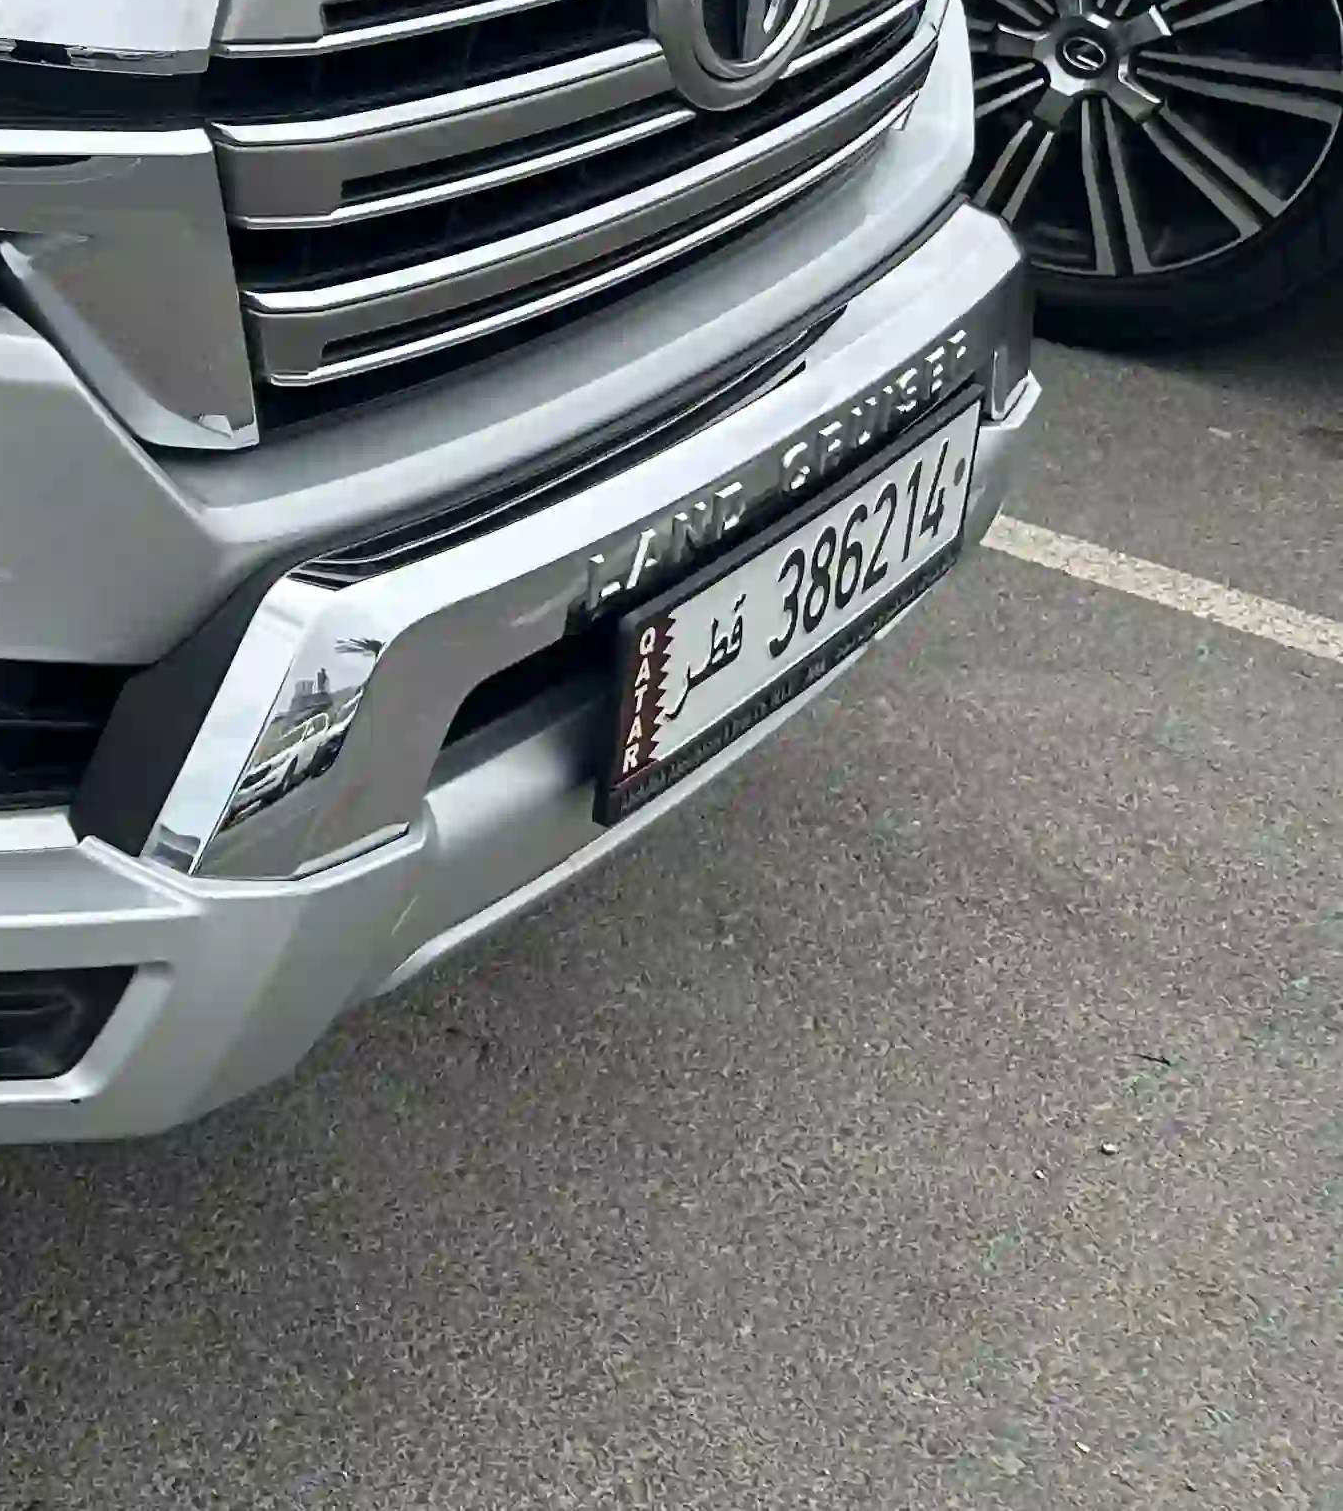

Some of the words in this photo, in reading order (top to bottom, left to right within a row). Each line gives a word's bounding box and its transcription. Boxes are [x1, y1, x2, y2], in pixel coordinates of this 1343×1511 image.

[586, 481, 747, 611] LAND
[780, 329, 968, 491] CRUISER
[767, 437, 951, 660] 386214
[621, 626, 656, 774] QATAR
[663, 593, 747, 722] قطر
